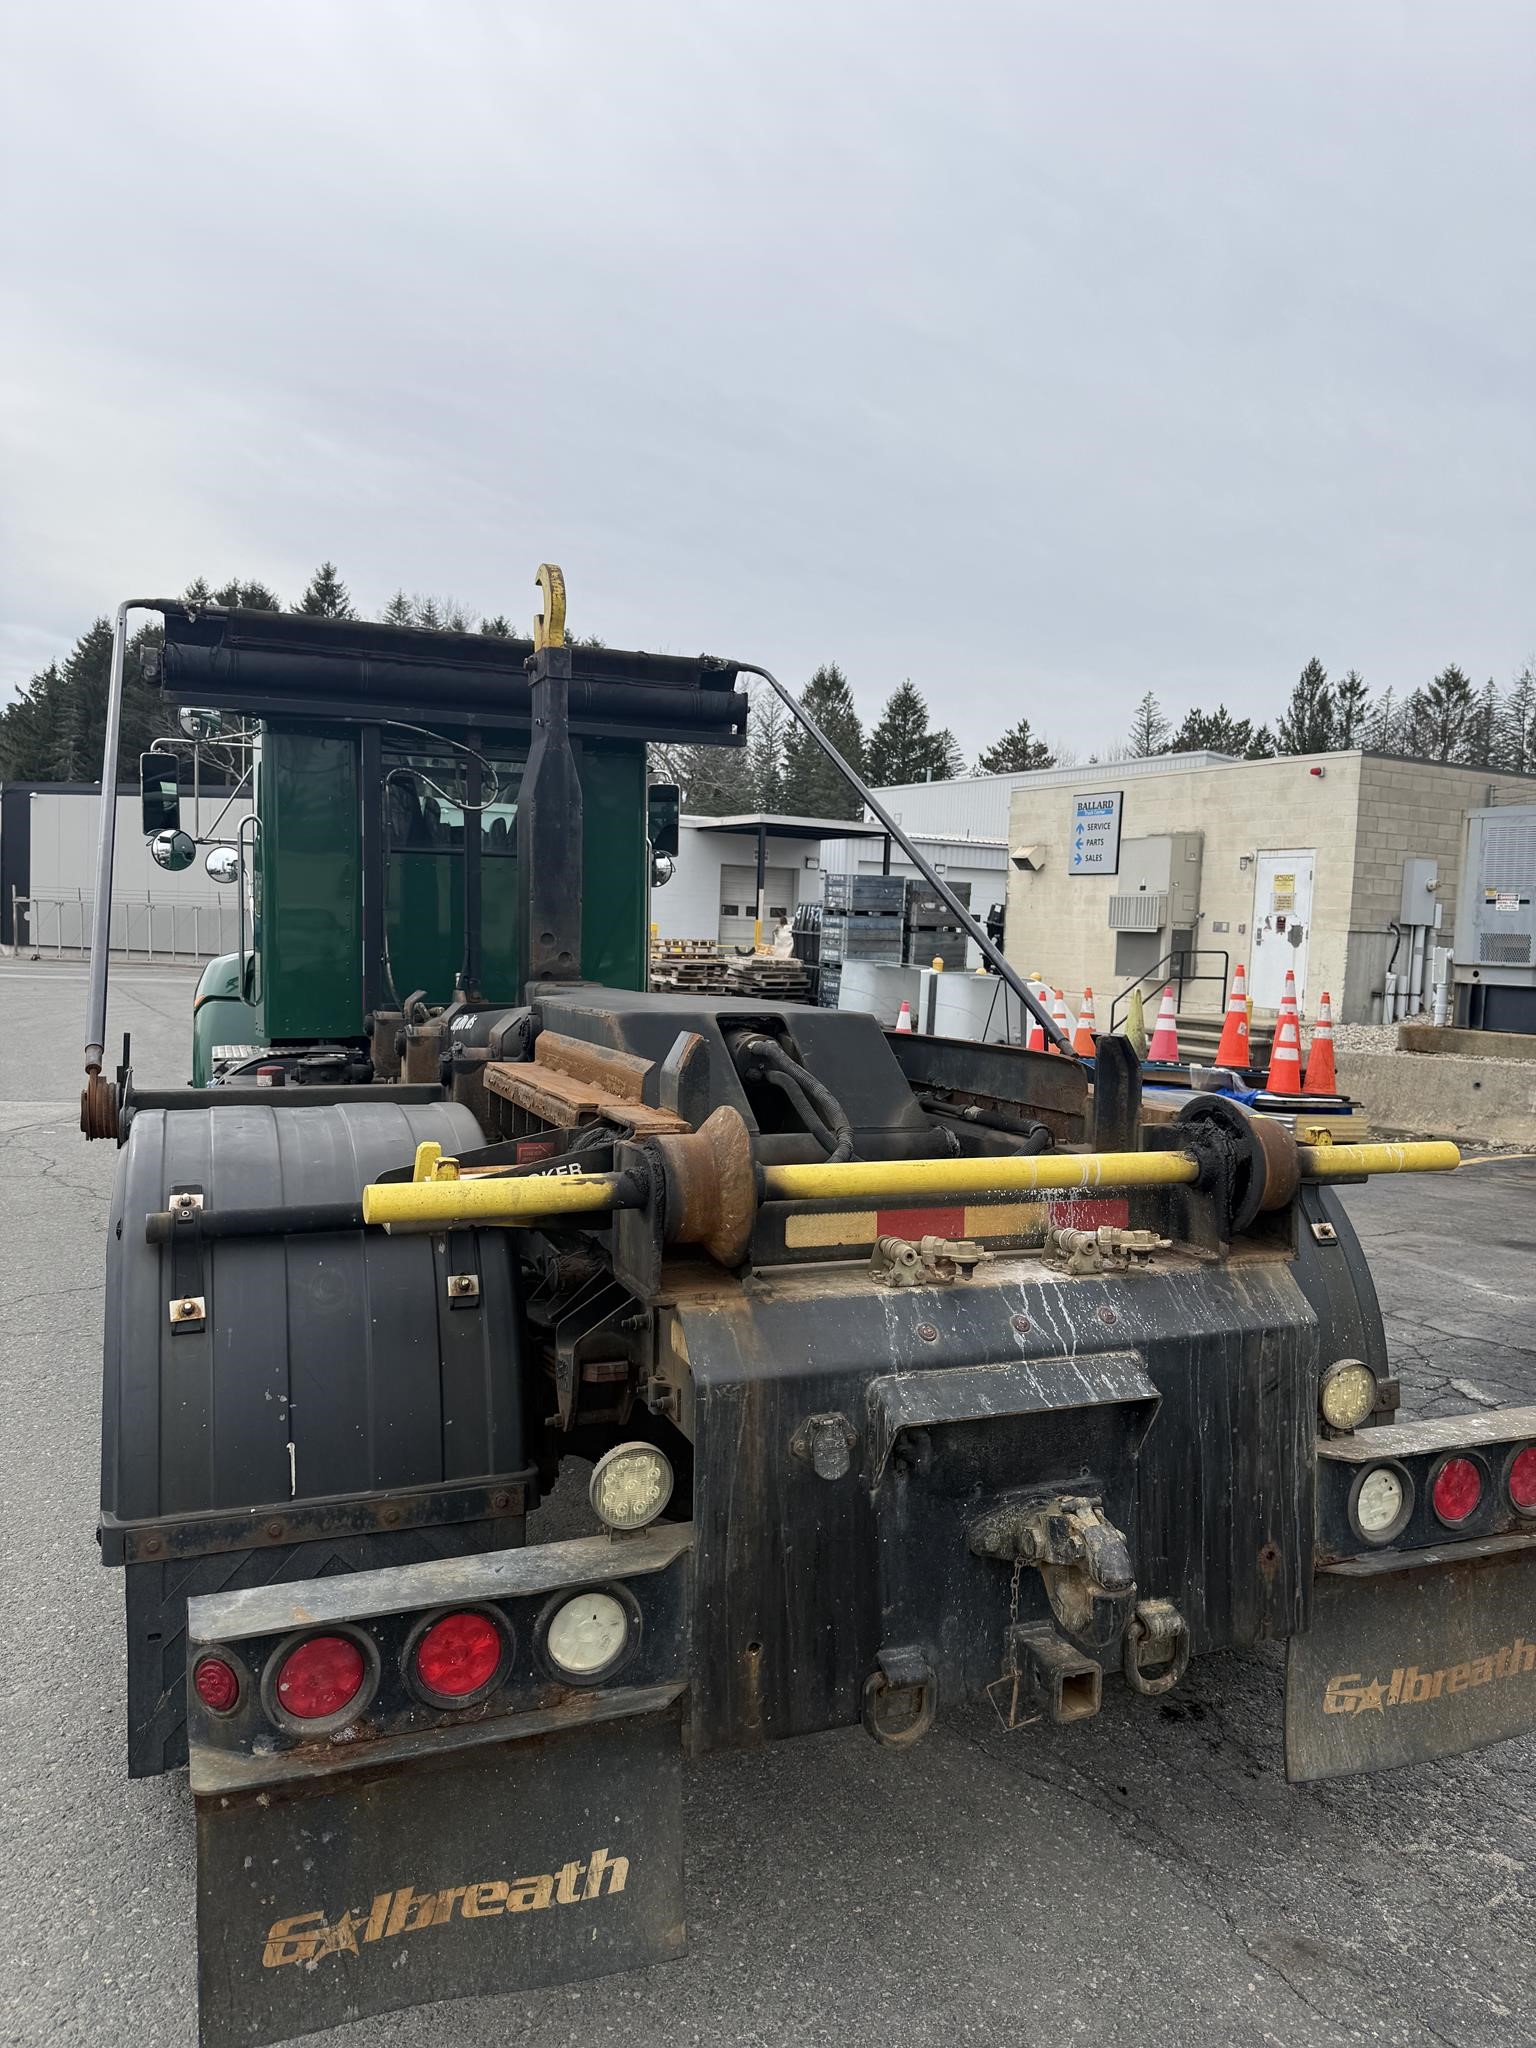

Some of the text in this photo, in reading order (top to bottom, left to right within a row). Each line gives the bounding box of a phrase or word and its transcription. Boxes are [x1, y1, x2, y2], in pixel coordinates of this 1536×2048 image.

[1077, 800, 1114, 811] BALLARD
[1087, 822, 1111, 831] SERVICE
[1086, 838, 1104, 847] PARTS
[1085, 853, 1102, 862] SALES
